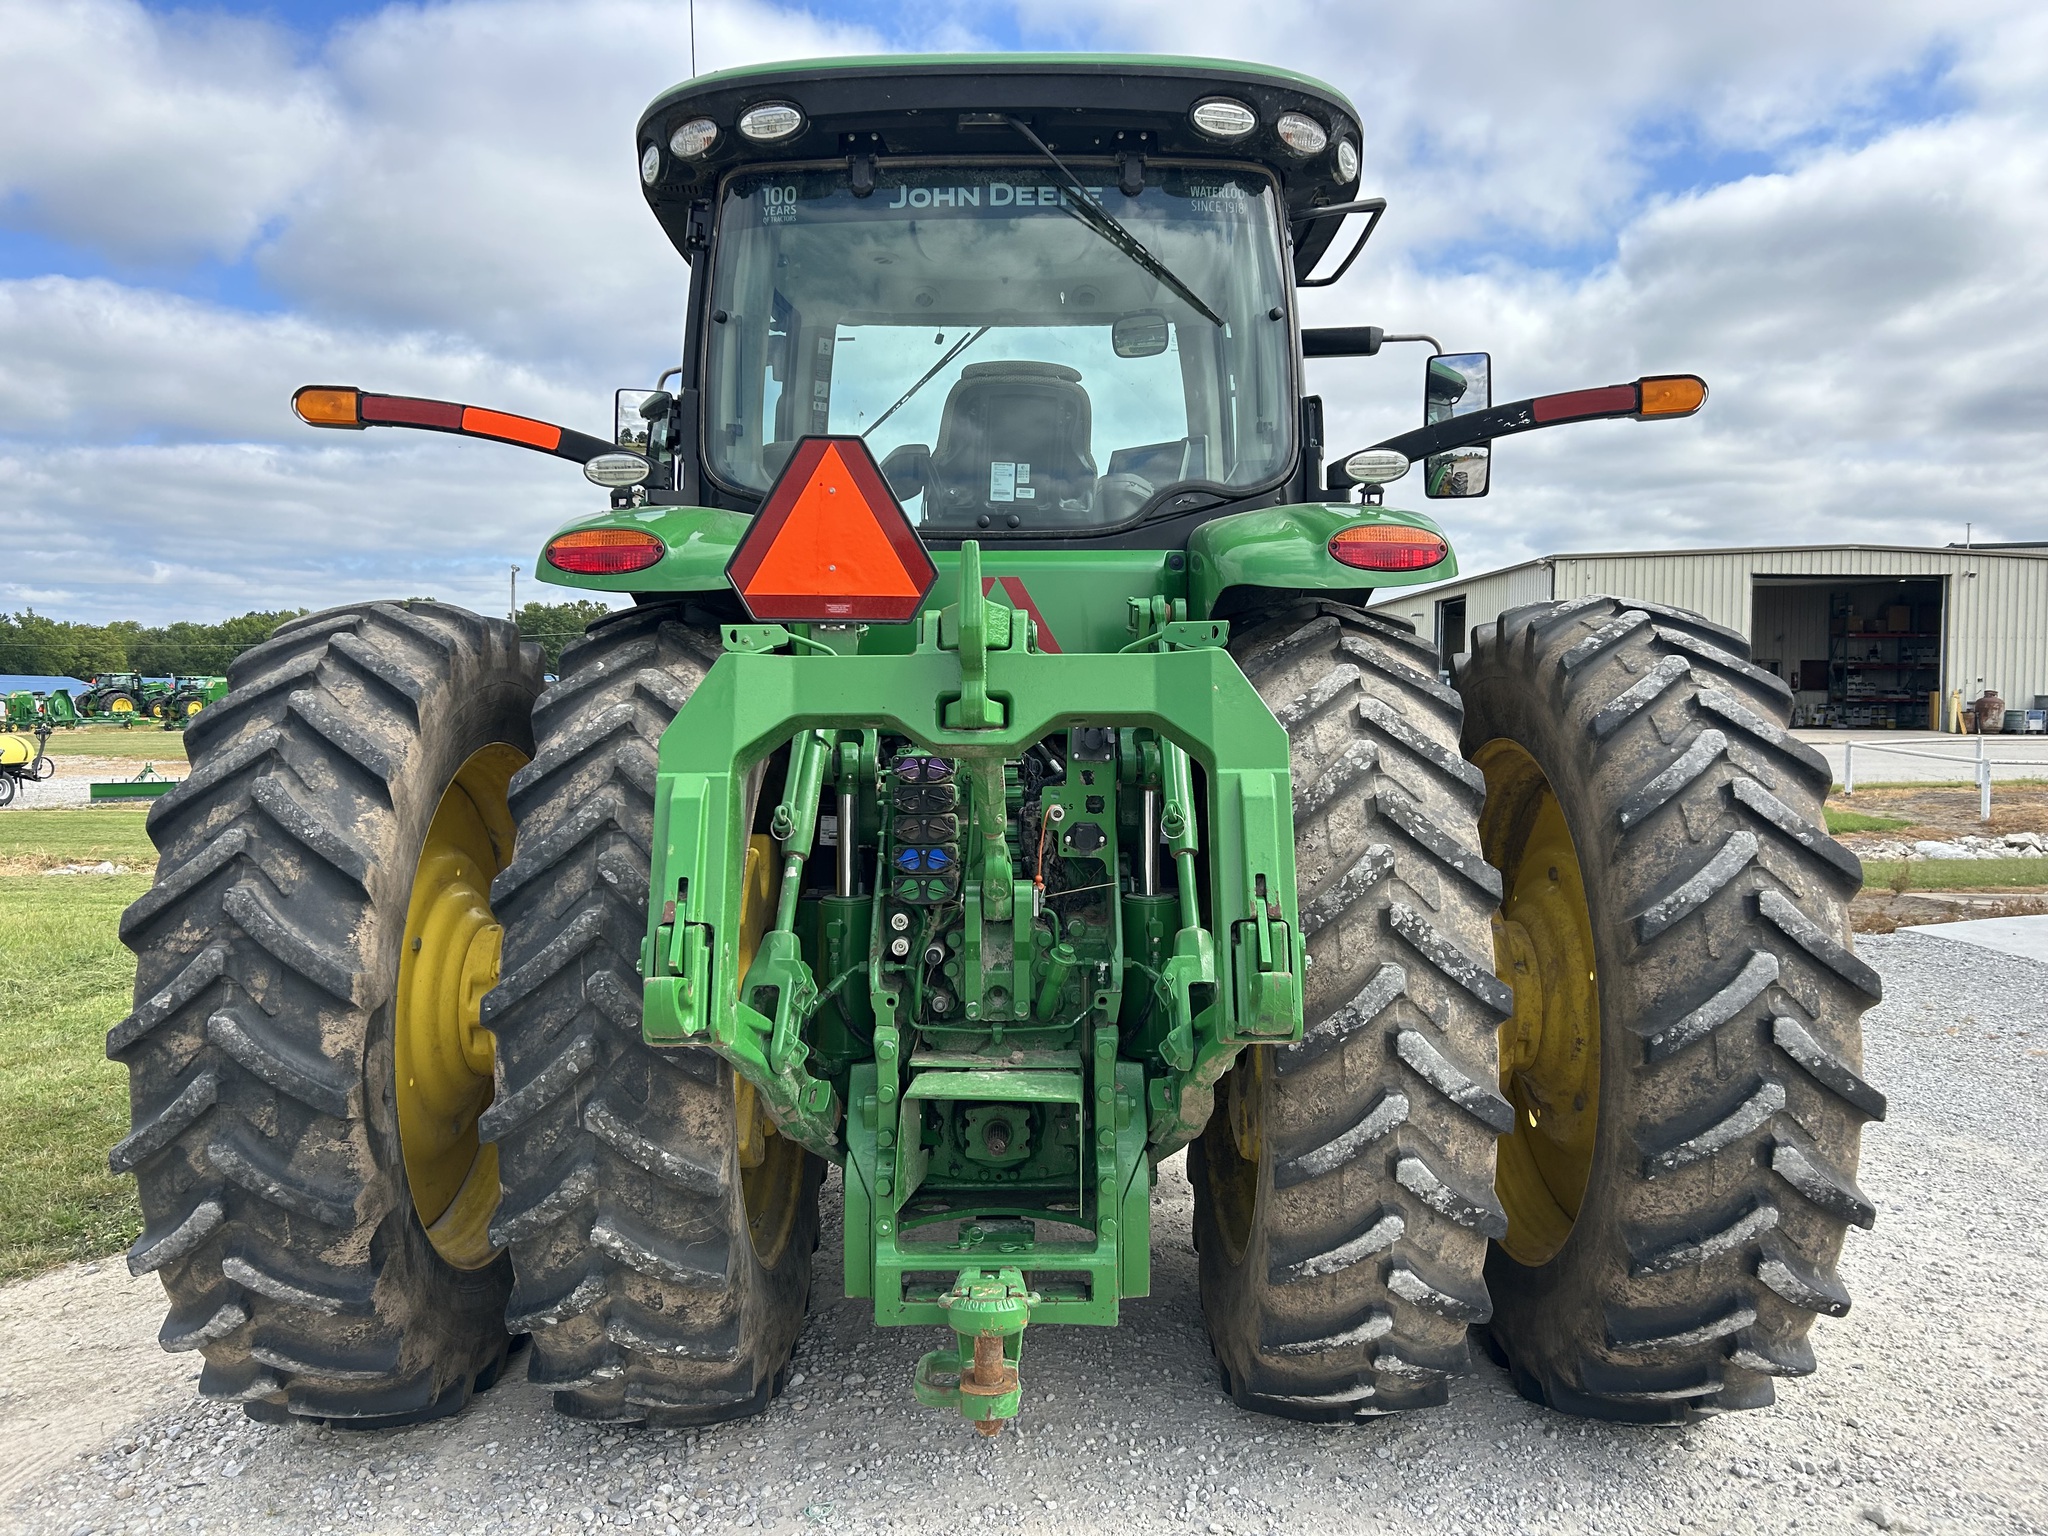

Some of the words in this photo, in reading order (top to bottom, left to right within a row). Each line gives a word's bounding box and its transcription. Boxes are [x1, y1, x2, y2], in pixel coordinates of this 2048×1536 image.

[763, 186, 796, 205] 100
[890, 184, 980, 208] JOHN
[1190, 186, 1245, 200] WATERLOO
[763, 205, 797, 216] YEARS
[1191, 200, 1221, 212] SINCE
[1225, 201, 1244, 214] 1918
